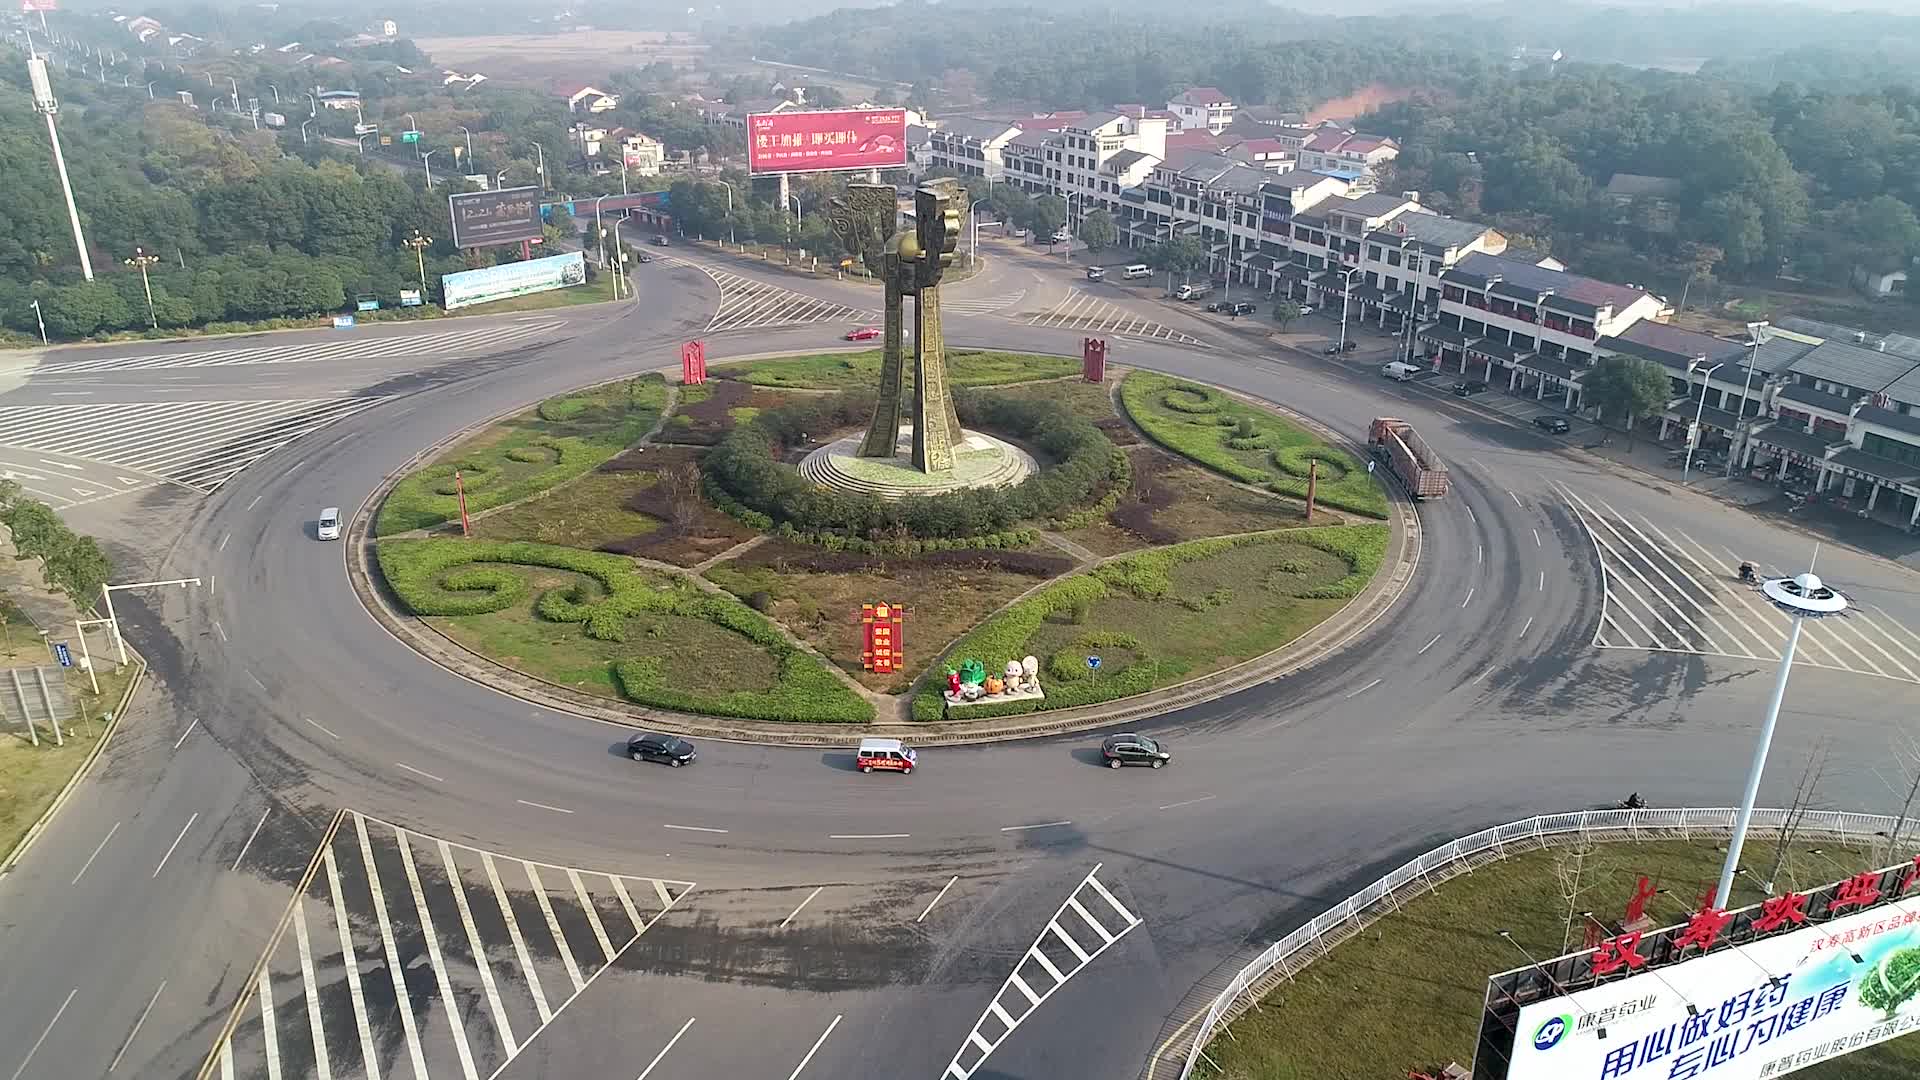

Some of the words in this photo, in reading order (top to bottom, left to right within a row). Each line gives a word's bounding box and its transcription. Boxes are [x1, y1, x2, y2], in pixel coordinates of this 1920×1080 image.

[1591, 854, 1920, 974] 汉寿欢迎
[1810, 911, 1920, 953] 汉寿高新区品牌
[1577, 994, 1657, 1031] 康普药业
[1600, 973, 1792, 1080] 用心做好药
[1667, 980, 1851, 1080] 专心为健康
